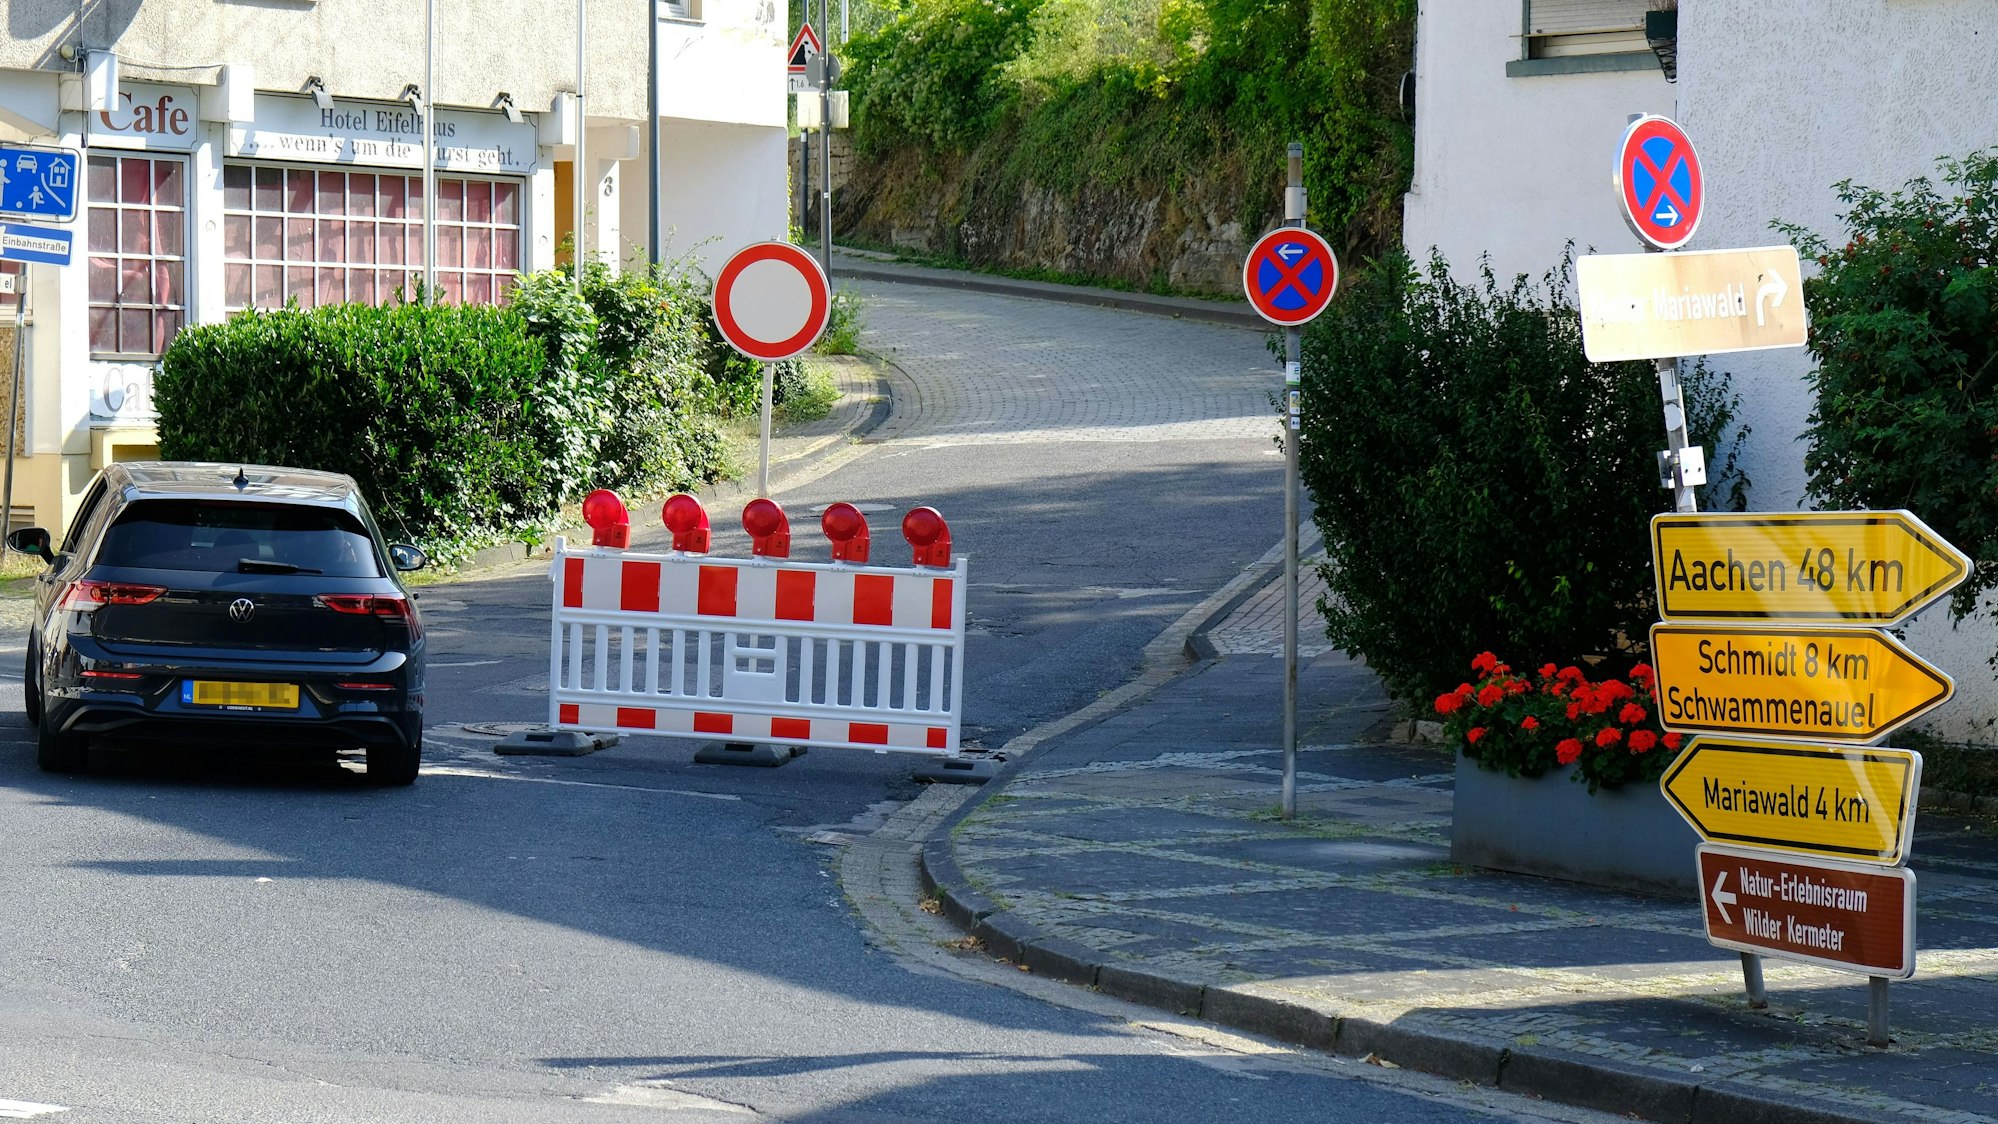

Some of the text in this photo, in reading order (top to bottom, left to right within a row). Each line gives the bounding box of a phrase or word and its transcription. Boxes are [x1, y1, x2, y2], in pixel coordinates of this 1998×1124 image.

[100, 91, 189, 135] Cafe
[320, 108, 368, 131] Hotel
[351, 141, 378, 156] um
[385, 137, 411, 159] die
[2, 236, 67, 252] Einbahnstraße
[1652, 283, 1747, 322] Mariawald
[1669, 547, 1904, 592] Aachen 48 km
[1698, 639, 1869, 680] Schmidt 8 km
[1668, 686, 1876, 729] Schwammenauel
[1703, 776, 1869, 823] Mariawald 4 km
[1739, 866, 1868, 913] Natur-Erlebnisraum
[1743, 907, 1845, 952] Wilder Kermeter
